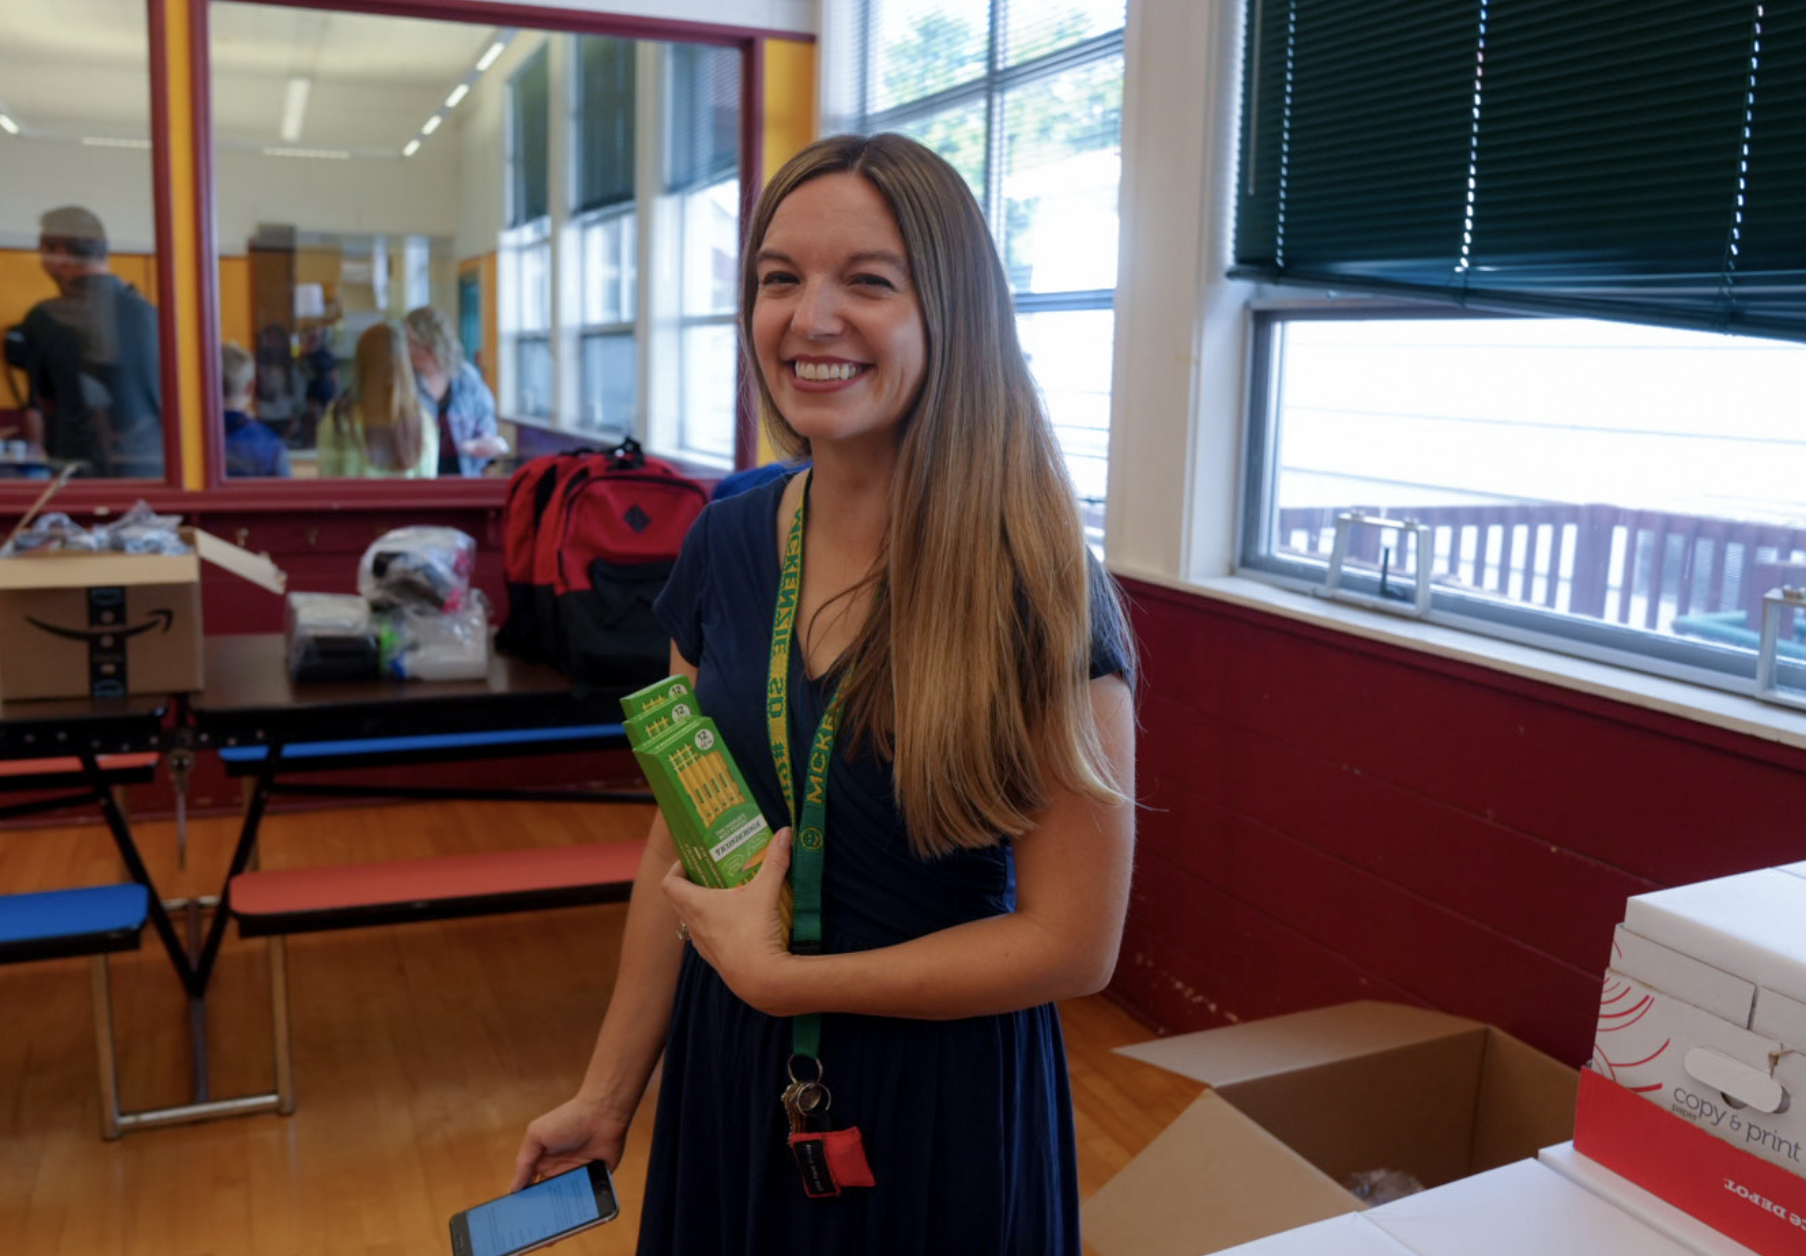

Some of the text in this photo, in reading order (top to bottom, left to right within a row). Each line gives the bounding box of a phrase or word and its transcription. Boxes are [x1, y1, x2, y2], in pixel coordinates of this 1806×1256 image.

[675, 705, 684, 715] 12
[697, 730, 707, 741] 12
[807, 710, 839, 803] MCKE
[1673, 1087, 1802, 1163] copy & print
[1723, 1178, 1789, 1220] DEPOT
